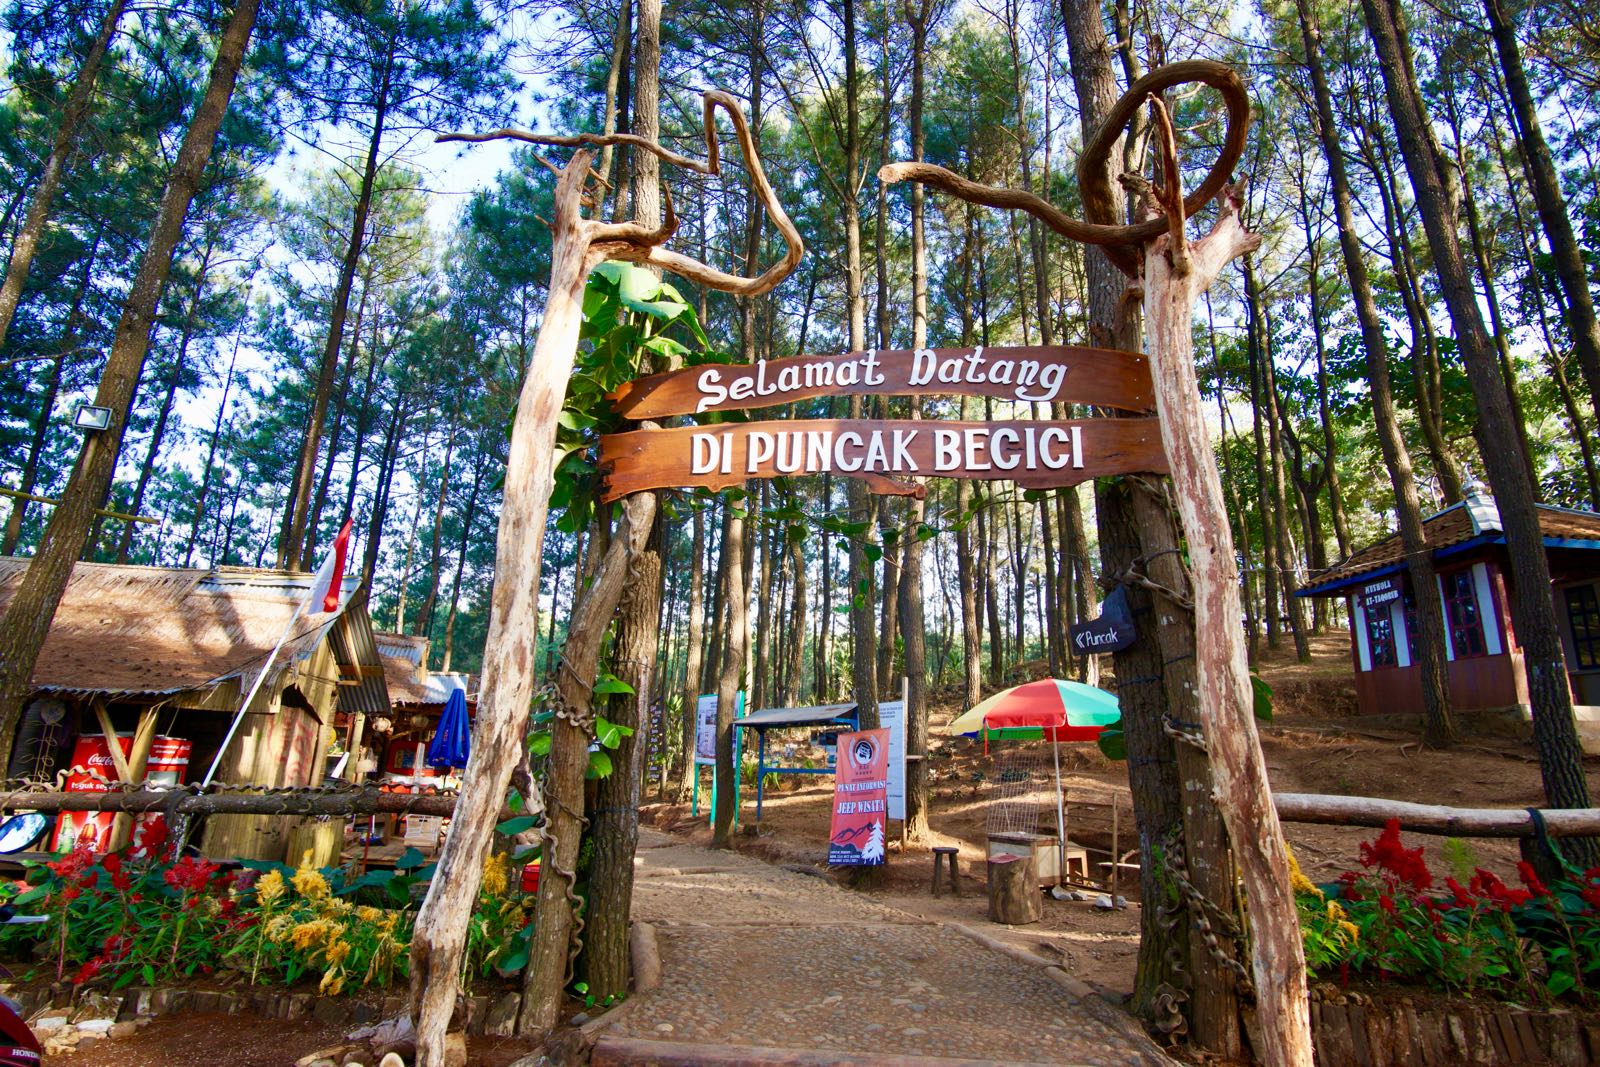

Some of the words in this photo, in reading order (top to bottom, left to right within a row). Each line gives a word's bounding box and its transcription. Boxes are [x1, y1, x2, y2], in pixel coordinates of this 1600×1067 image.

[696, 348, 886, 413] Selamat
[908, 345, 1068, 400] Datang
[692, 432, 734, 474] DI
[747, 429, 919, 473] PUNCAK
[934, 426, 1084, 472] BECICI
[1085, 627, 1118, 646] Puncak
[837, 801, 856, 814] JEEP
[857, 799, 885, 813] WISATA
